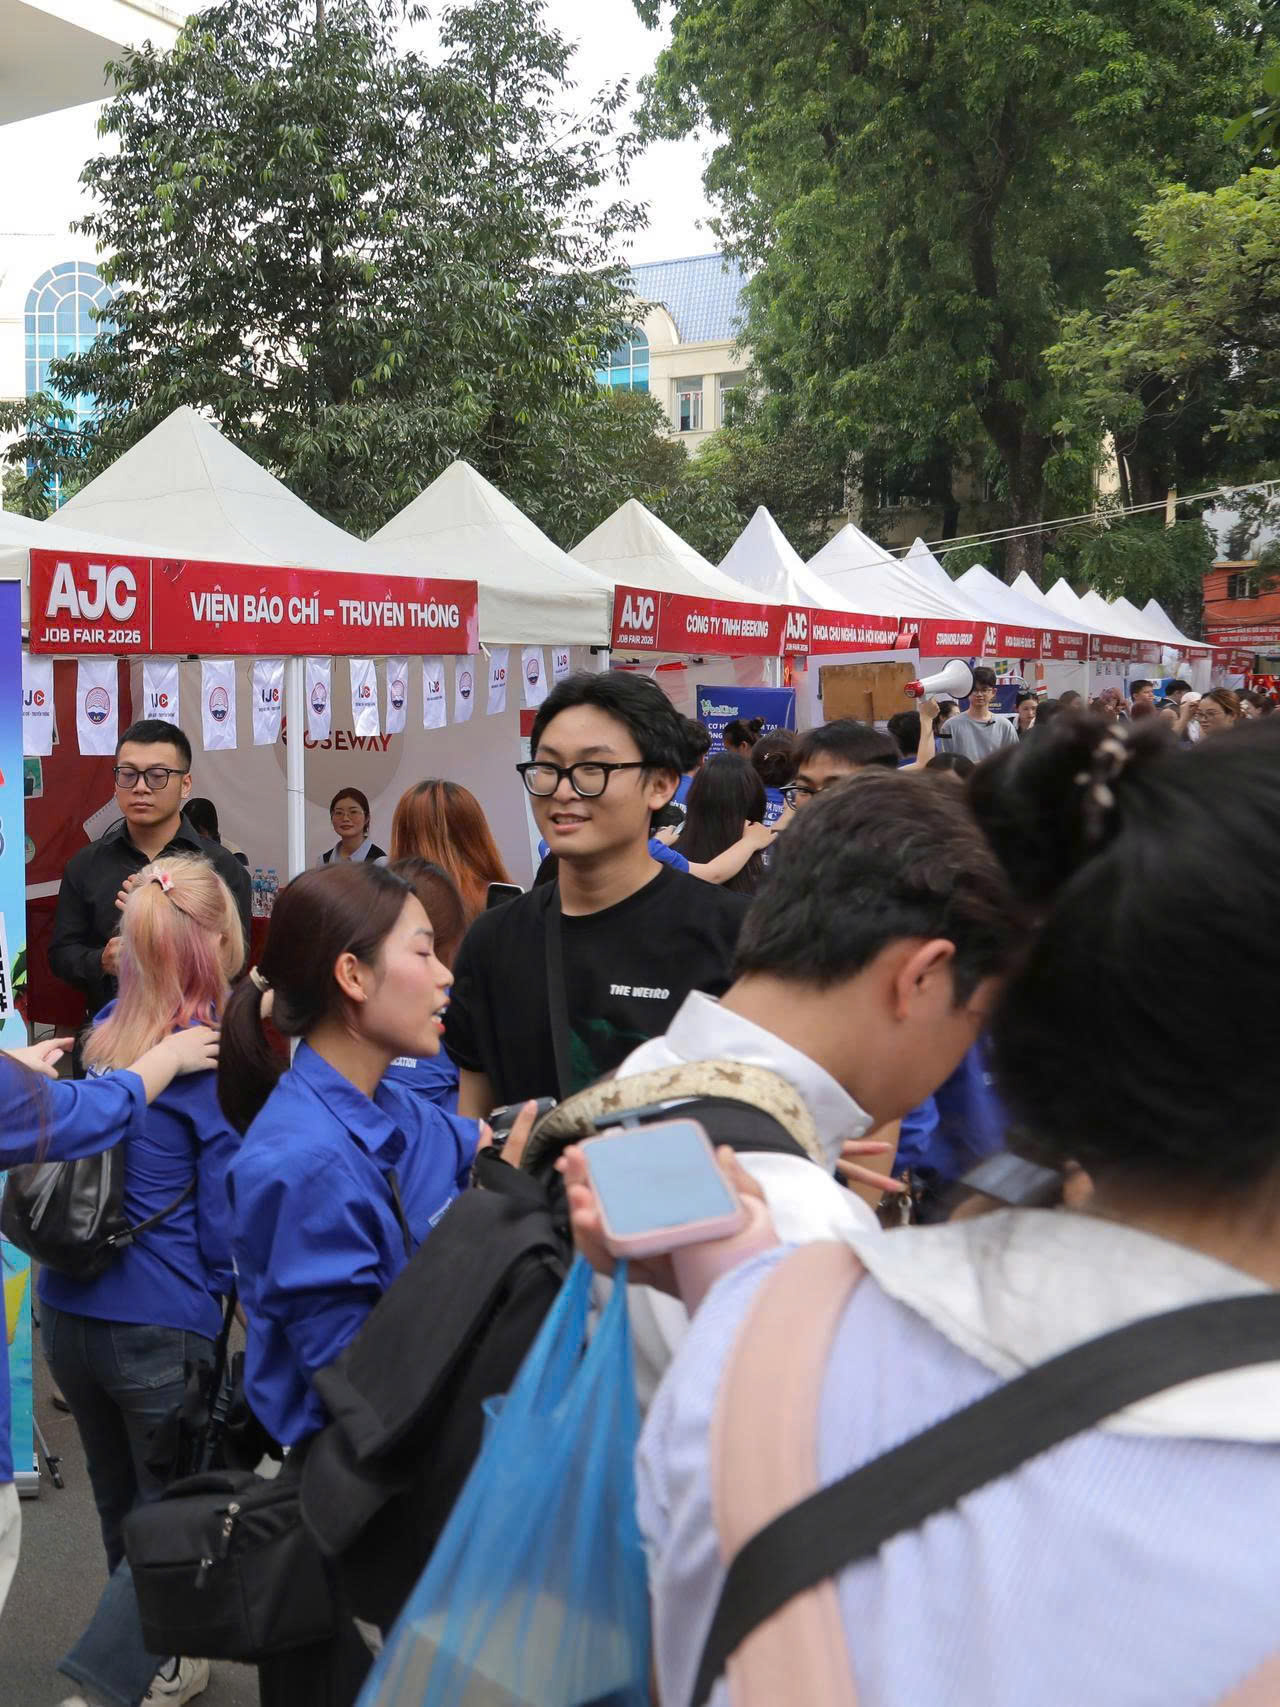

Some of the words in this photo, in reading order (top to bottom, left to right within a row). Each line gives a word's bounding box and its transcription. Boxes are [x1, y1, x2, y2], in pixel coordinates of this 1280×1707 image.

[45, 562, 137, 622] AJC
[189, 584, 239, 629] VIỆN
[243, 586, 284, 623] BÁO
[288, 588, 320, 623] CHÍ
[338, 588, 404, 627] TRUYỀN
[407, 596, 460, 629] THÔNG
[621, 595, 655, 630] AJC
[40, 627, 71, 643] JOB
[73, 628, 105, 644] FAIR
[107, 628, 141, 645] 2026
[686, 609, 708, 635] CÔNG
[710, 617, 721, 635] TY
[721, 618, 741, 636] TNHH
[741, 619, 769, 638] BEEKING
[787, 612, 807, 640] AJC
[616, 634, 628, 643] JOB
[628, 635, 640, 644] FAIR
[641, 636, 653, 644] 2026
[303, 730, 393, 752] OSEWAY
[610, 984, 631, 997] THE
[632, 987, 670, 1000] WEIRD
